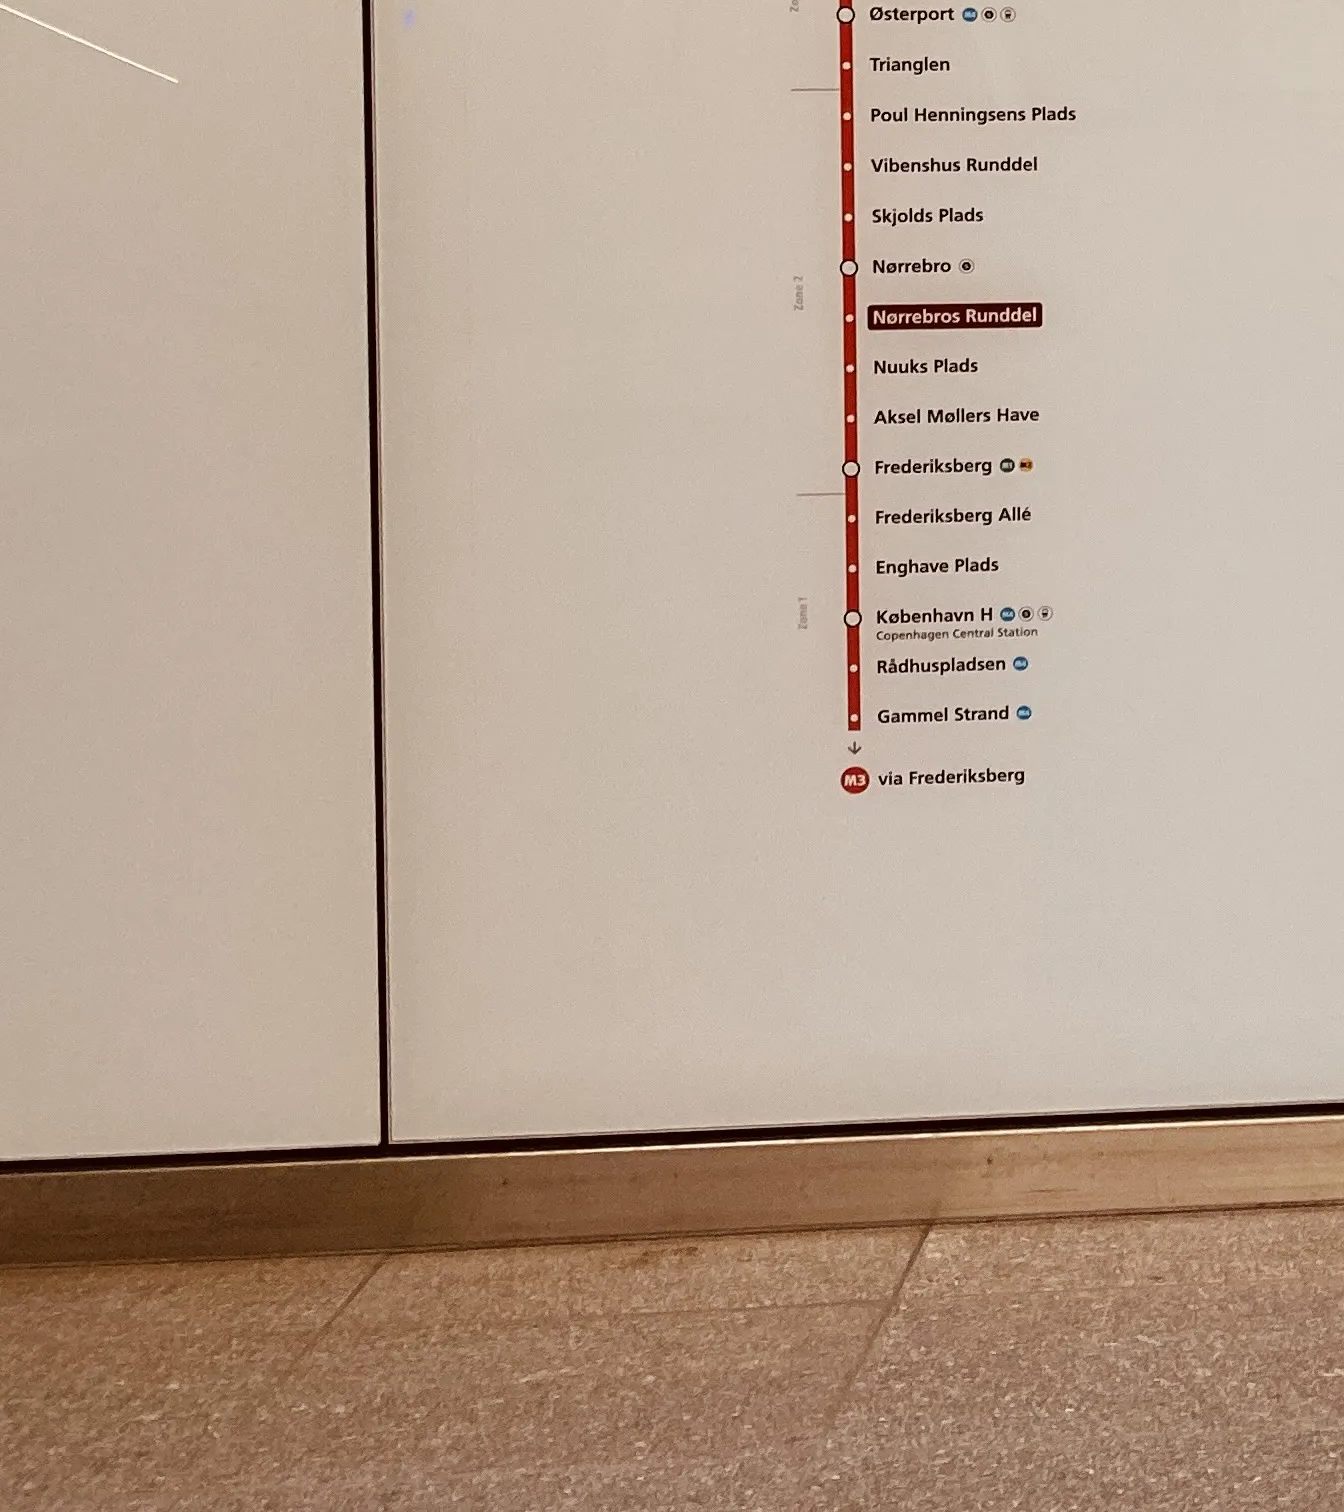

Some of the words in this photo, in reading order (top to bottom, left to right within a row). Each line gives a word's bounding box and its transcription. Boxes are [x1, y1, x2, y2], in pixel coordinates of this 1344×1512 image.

[870, 7, 954, 24] Østerport
[869, 57, 950, 75] Trianglen
[871, 108, 907, 122] Poul
[915, 107, 1025, 125] Henningsens
[1032, 106, 1076, 121] Plads
[871, 158, 960, 172] Vibenshus
[967, 157, 1037, 171] Runddel
[873, 208, 932, 227] Skjolds
[940, 208, 983, 222] Plads
[873, 259, 951, 273] Nørrebro
[794, 285, 804, 311] Zone
[873, 309, 960, 325] Nørrebros
[965, 307, 1037, 323] Runddel
[874, 359, 927, 374] Nuuks
[934, 358, 978, 373] Plads
[874, 409, 920, 424] Aksel
[928, 408, 990, 423] Møllers
[998, 408, 1039, 422] Have
[876, 458, 991, 475] Frederiksberg
[876, 508, 992, 525] Frederiksberg
[999, 507, 1031, 521] Allé
[877, 559, 948, 577] Enghave
[955, 557, 998, 572] Plads
[877, 608, 974, 624] København
[981, 607, 992, 621] H
[876, 629, 949, 642] Copenhagen
[953, 628, 993, 638] Central
[998, 628, 1037, 637] Station
[878, 657, 1005, 675] Rådhuspladsen
[878, 707, 947, 723] Gammel
[955, 705, 1009, 721] Strand
[843, 774, 867, 788] M3
[878, 771, 902, 785] via
[910, 768, 1024, 785] Frederiksberg
